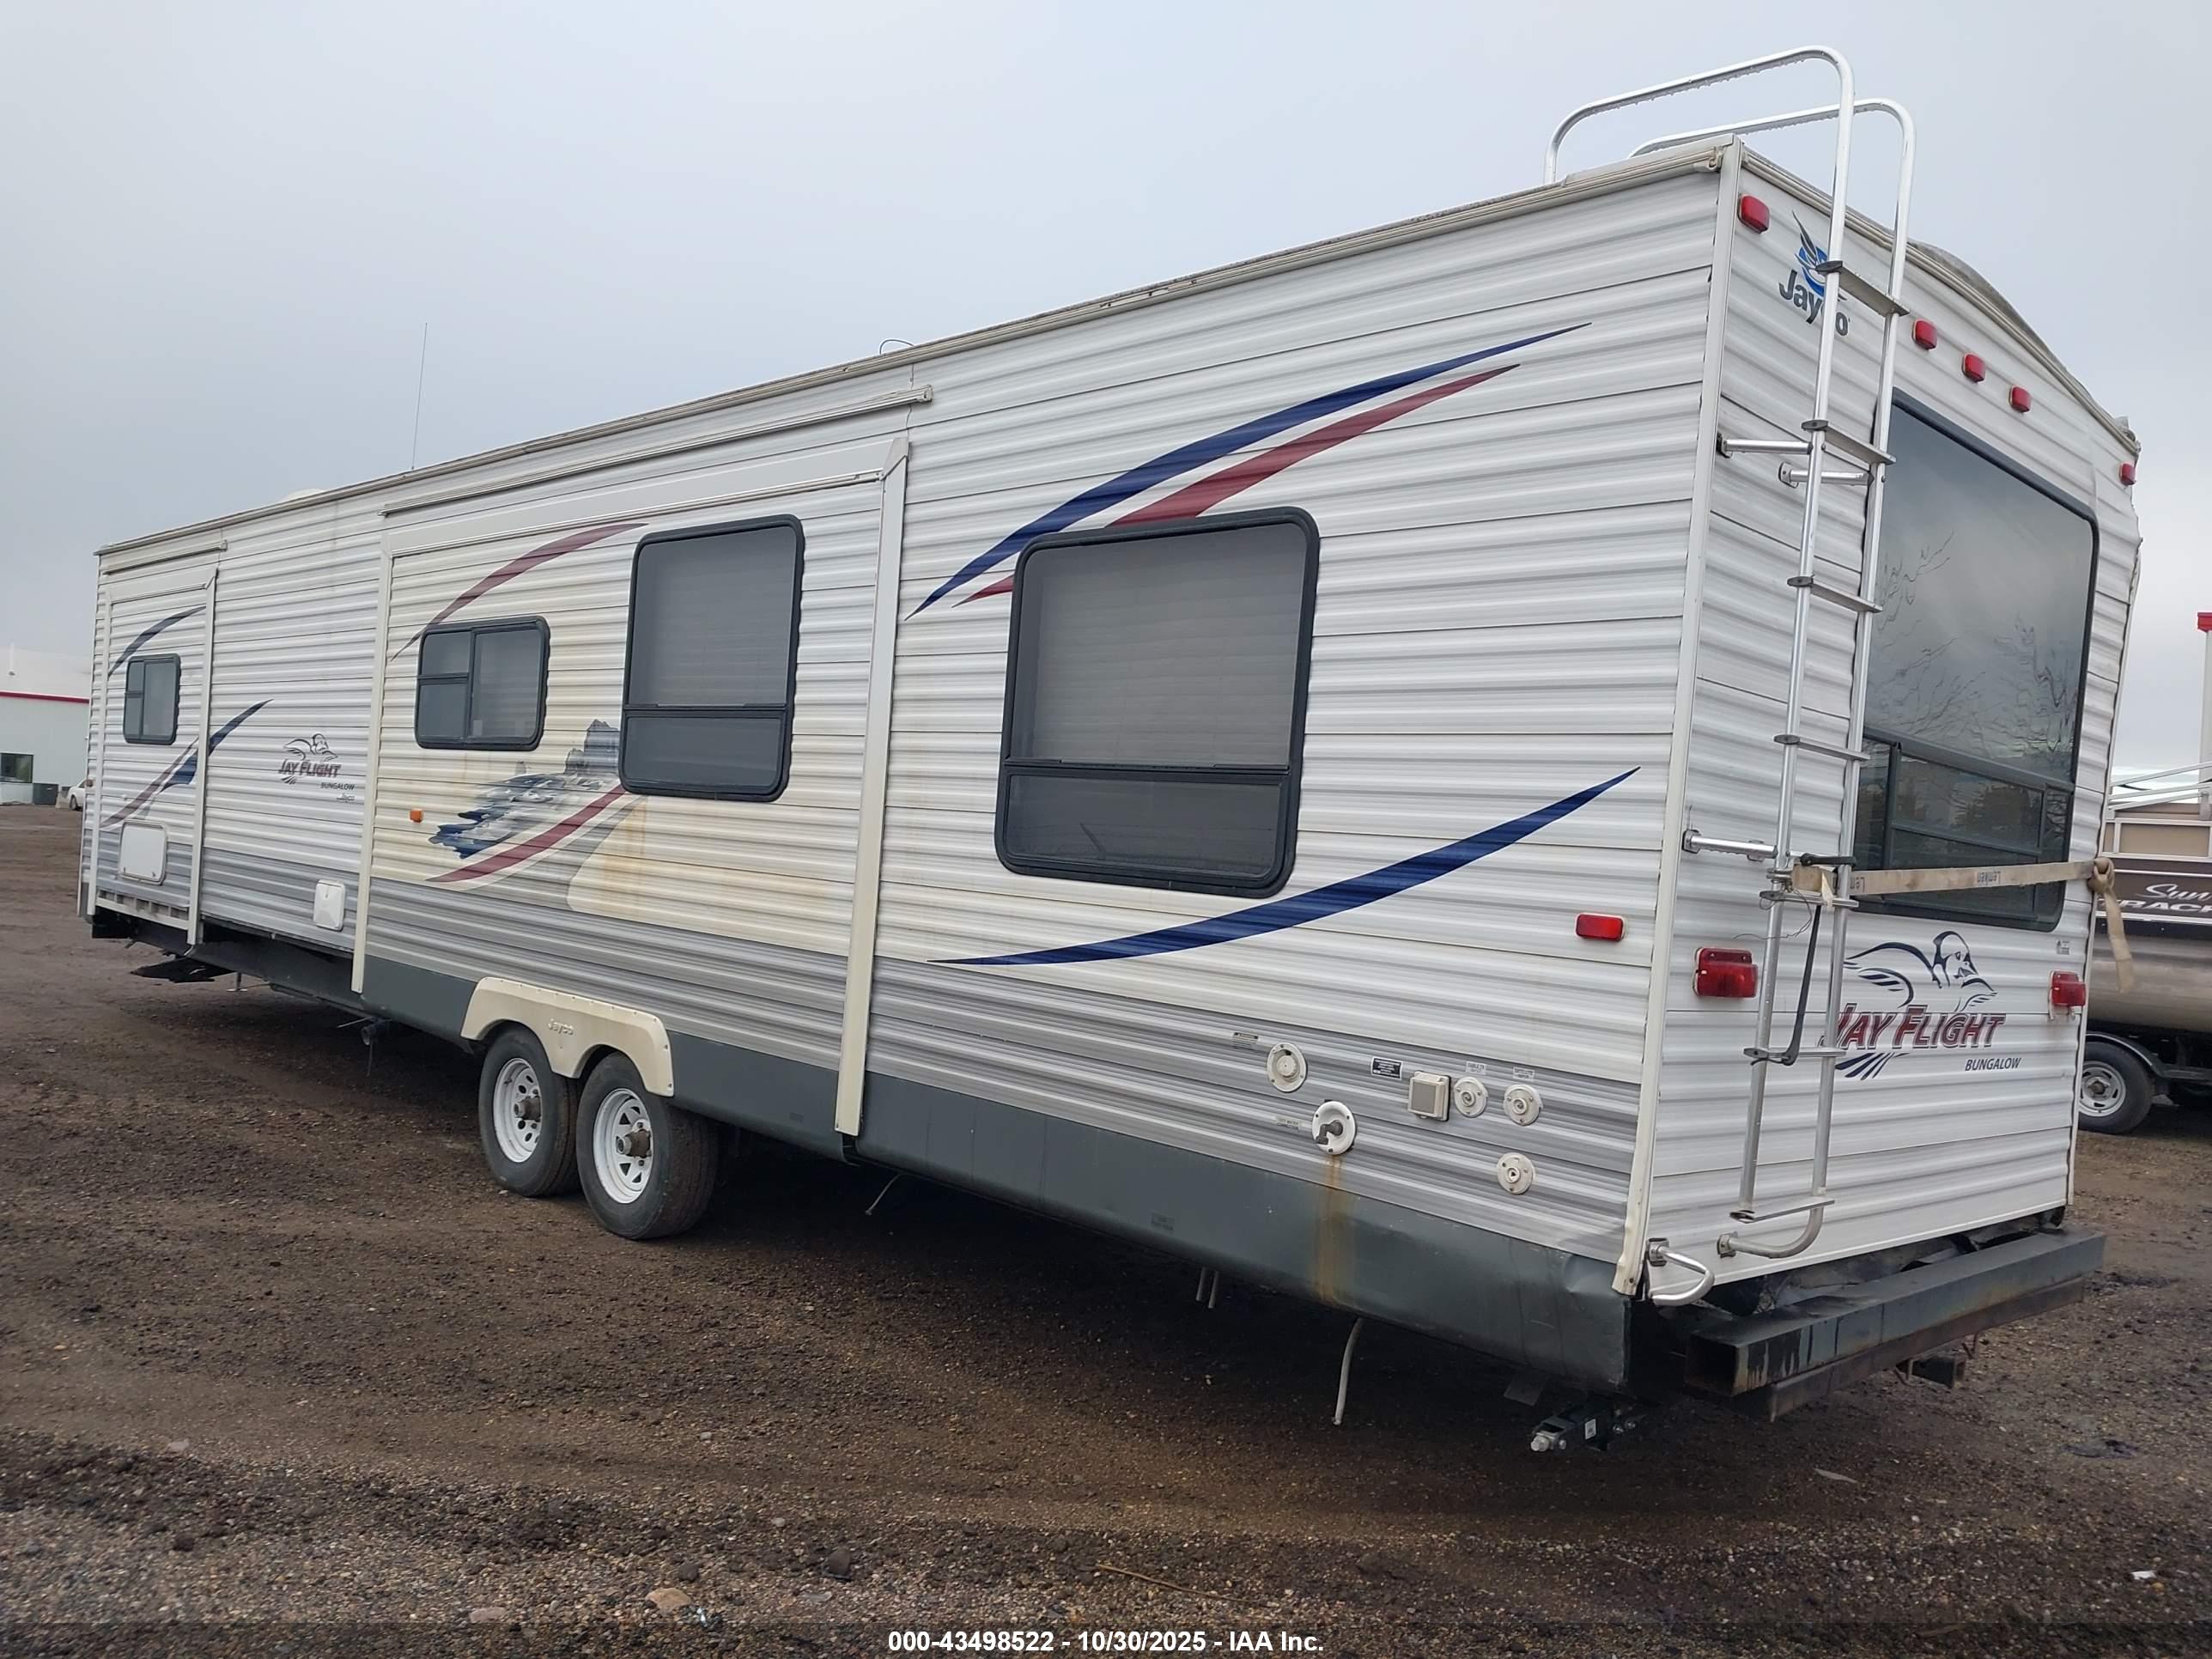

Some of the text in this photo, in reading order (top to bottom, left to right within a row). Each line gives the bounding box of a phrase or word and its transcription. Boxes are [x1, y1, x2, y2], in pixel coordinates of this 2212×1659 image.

[1778, 269, 1848, 336] Jayo
[300, 759, 342, 779] FLIGHT
[320, 781, 355, 791] BUNGALOW
[548, 1017, 574, 1035] Jayco
[1892, 1005, 2006, 1048] FLIGHT
[1965, 1057, 2021, 1072] BUNGALOW
